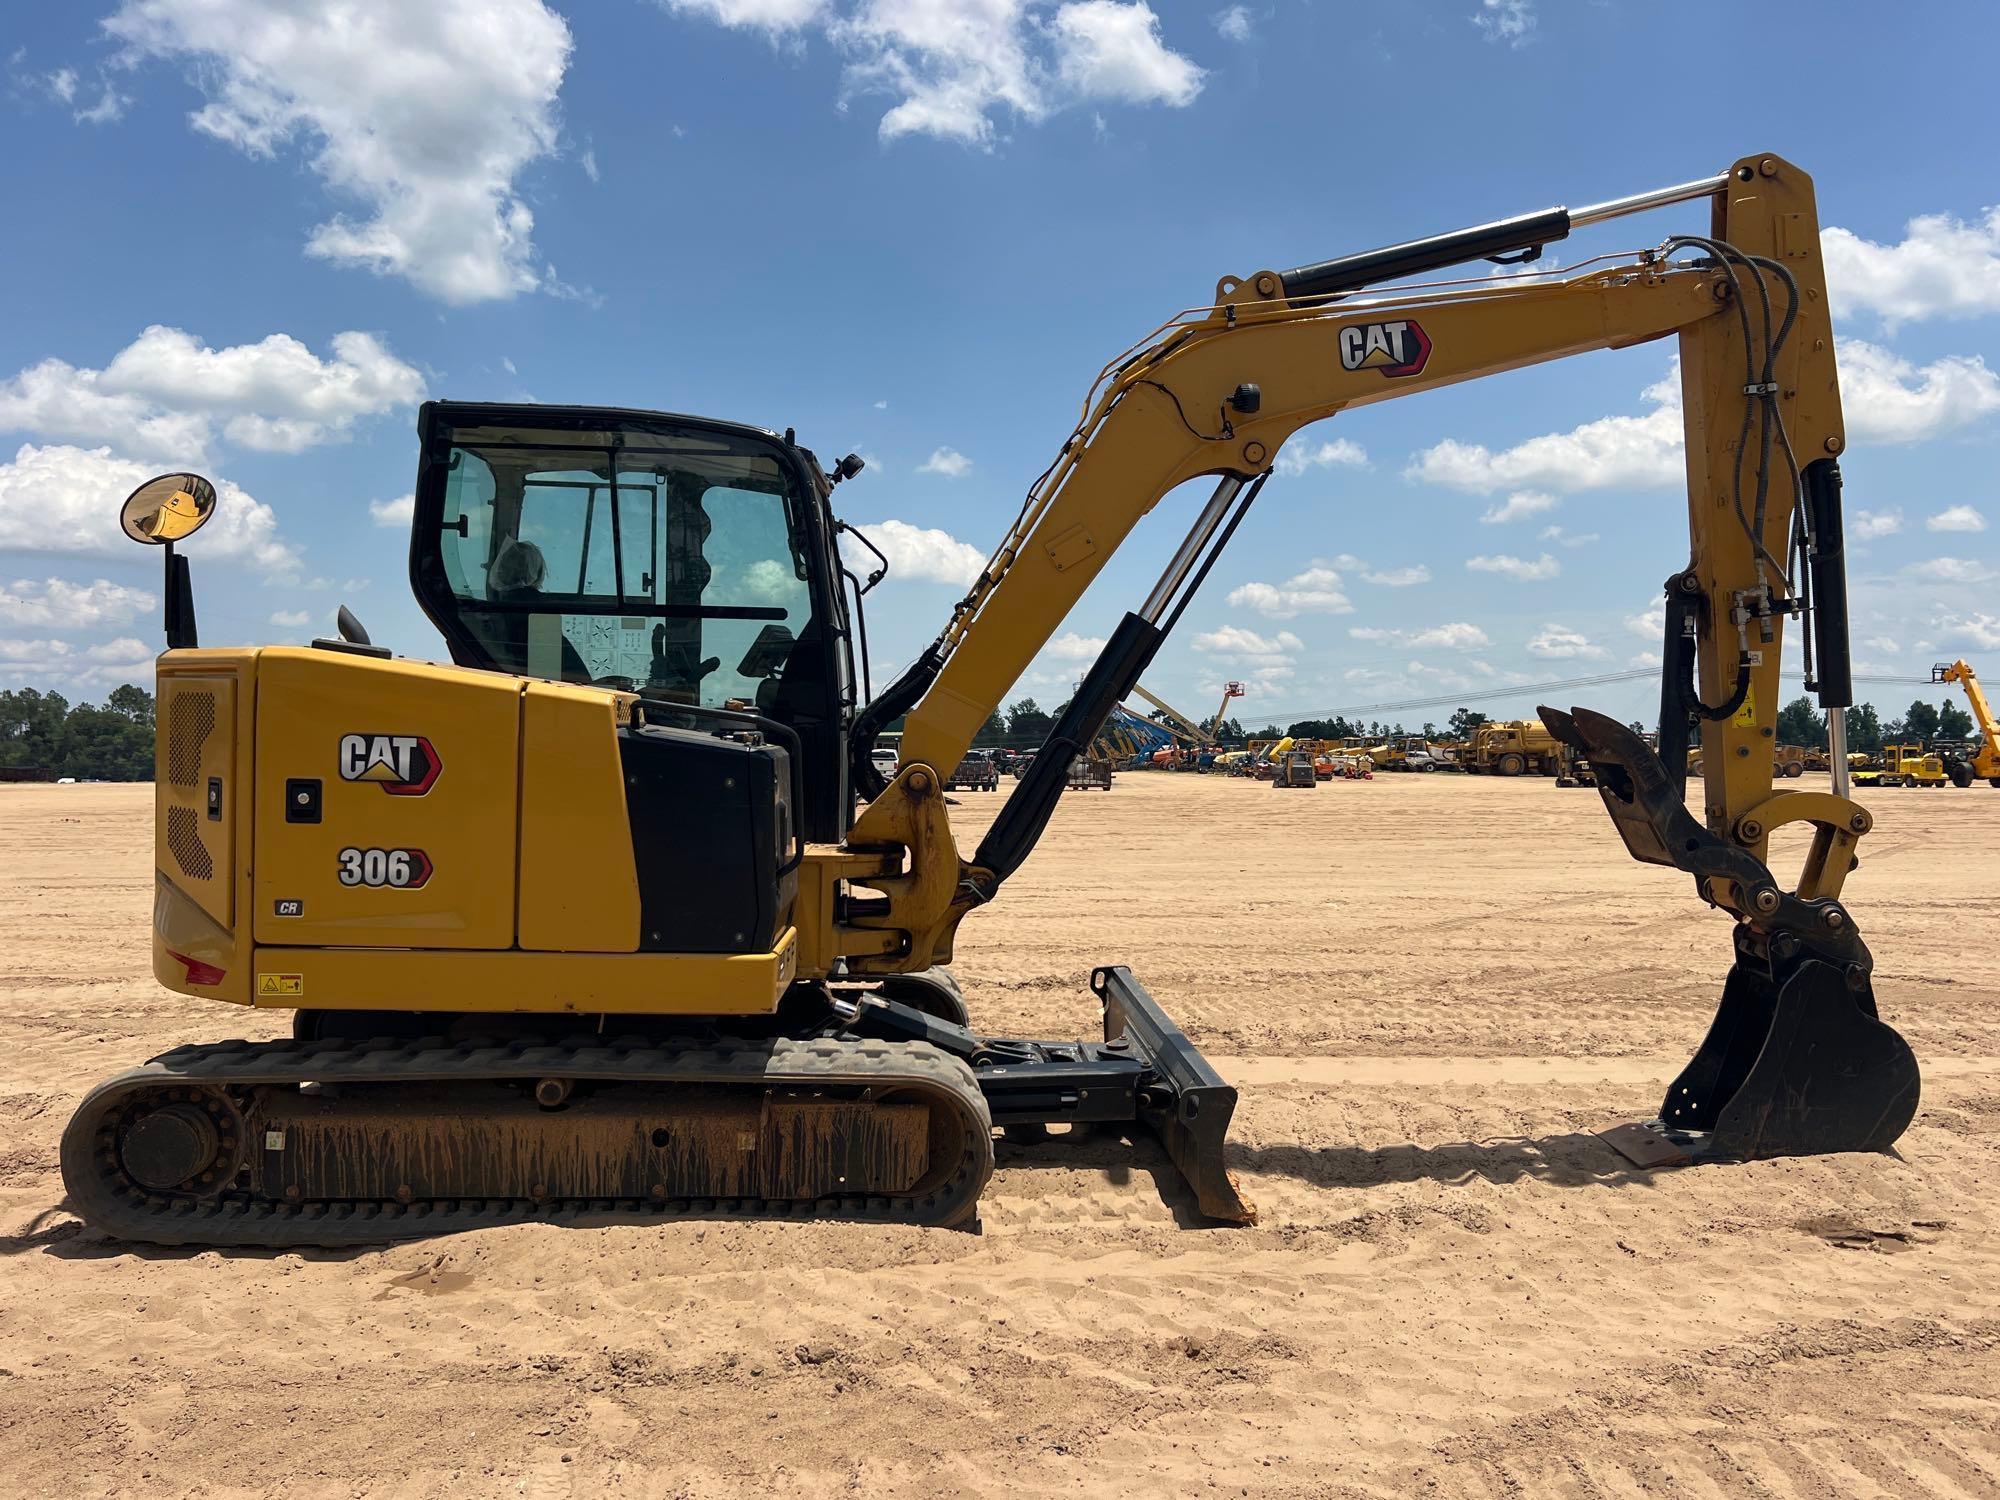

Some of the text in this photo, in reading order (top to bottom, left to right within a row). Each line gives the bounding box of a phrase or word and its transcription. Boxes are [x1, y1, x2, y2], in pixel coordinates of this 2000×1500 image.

[1340, 321, 1407, 370] CAT
[341, 735, 418, 781] CAT
[340, 848, 410, 886] 306
[279, 902, 298, 914] CR
